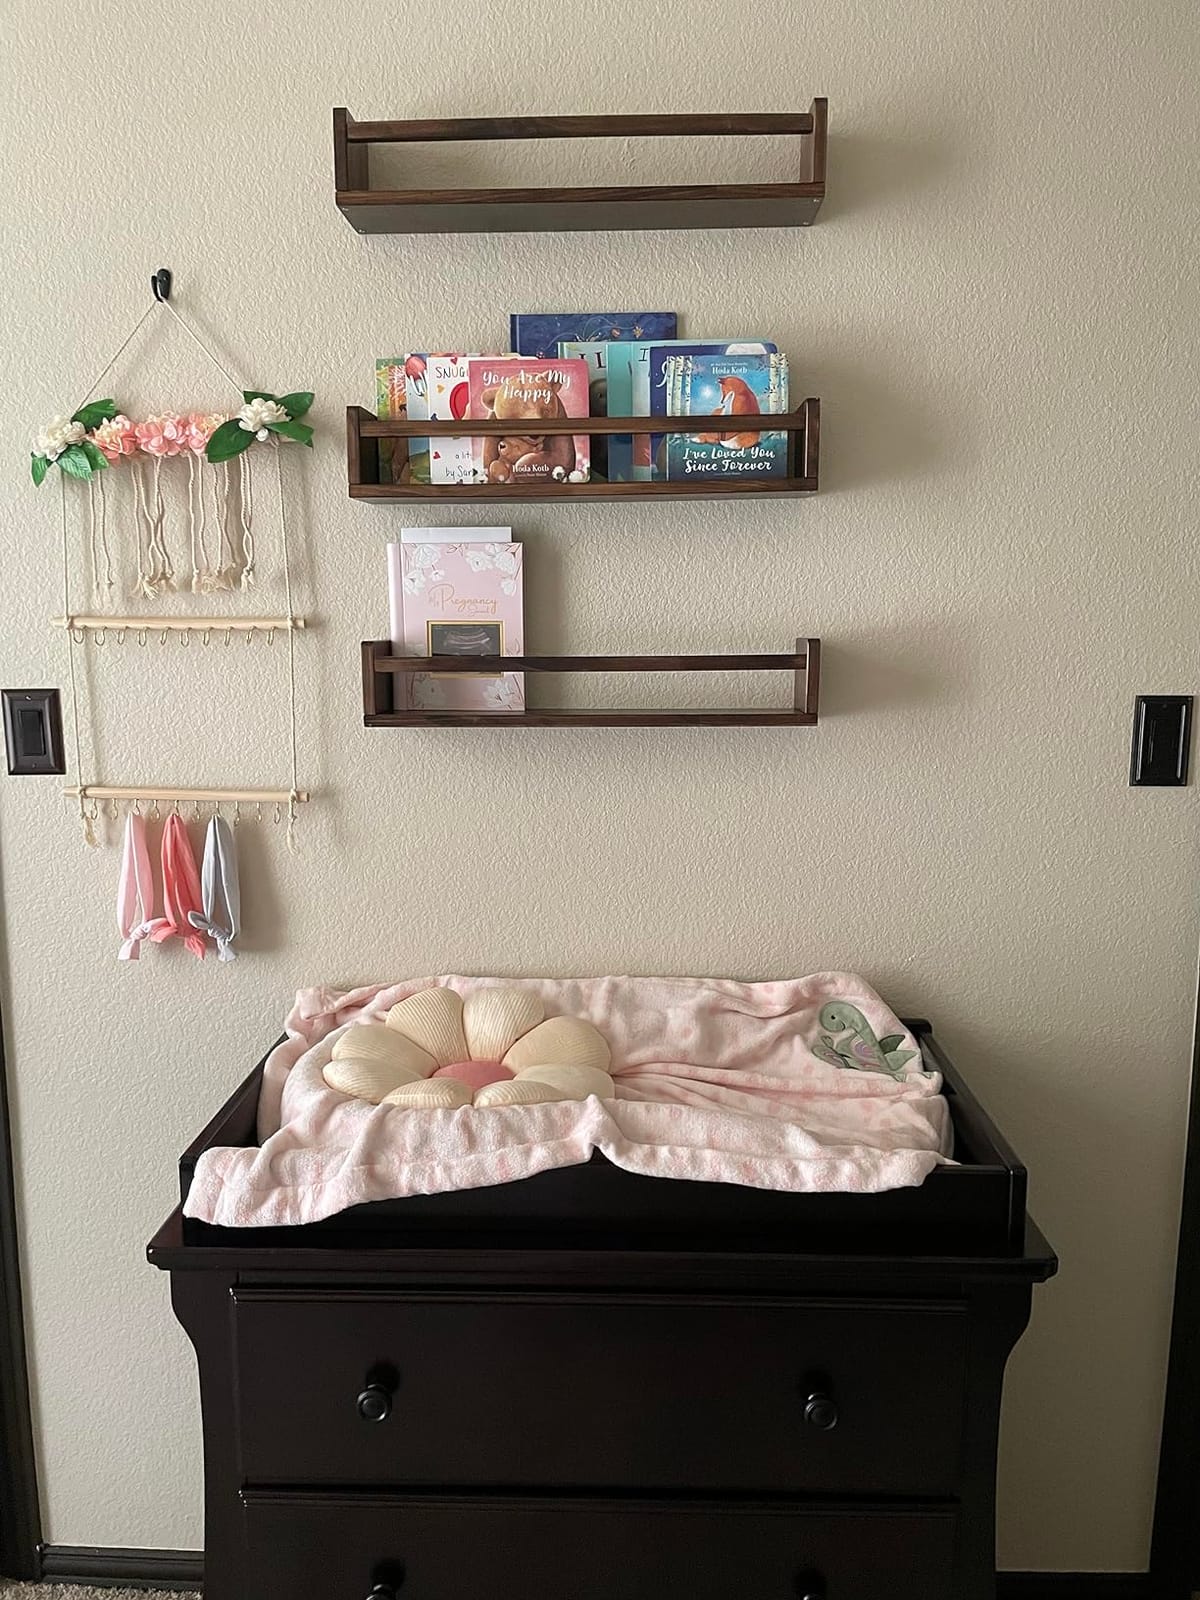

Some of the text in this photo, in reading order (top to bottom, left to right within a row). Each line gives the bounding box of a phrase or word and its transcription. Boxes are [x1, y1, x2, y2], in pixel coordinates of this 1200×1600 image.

[482, 369, 571, 389] You Are My
[503, 385, 552, 404] Happy
[682, 446, 775, 460] I've Loved You
[445, 466, 456, 480] by
[512, 464, 550, 473] Hoda Kotb
[684, 459, 772, 473] Since Forever
